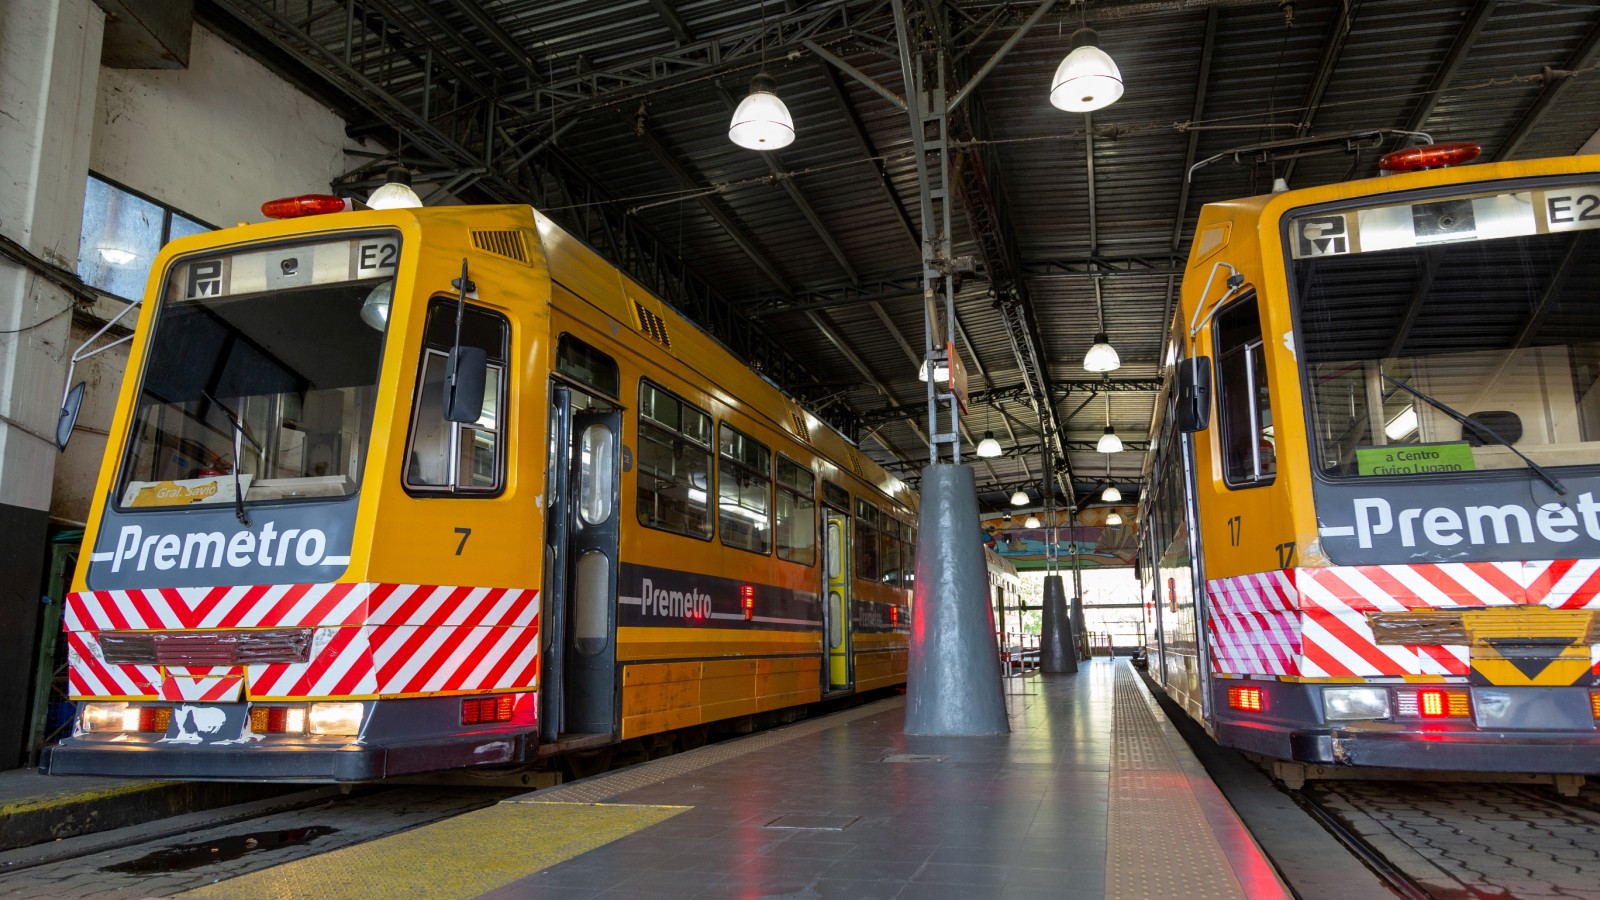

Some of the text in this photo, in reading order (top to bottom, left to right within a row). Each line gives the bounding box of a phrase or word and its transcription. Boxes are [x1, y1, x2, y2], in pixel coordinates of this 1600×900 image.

[1548, 194, 1600, 224] E2
[360, 243, 396, 270] E2
[1386, 450, 1440, 462] a Centro
[156, 486, 182, 499] Gral.
[1227, 515, 1241, 547] 17
[1353, 491, 1600, 549] Premet
[111, 521, 327, 573] Premetro
[454, 527, 472, 556] 7
[1275, 541, 1296, 569] 17
[641, 577, 712, 619] Premetro
